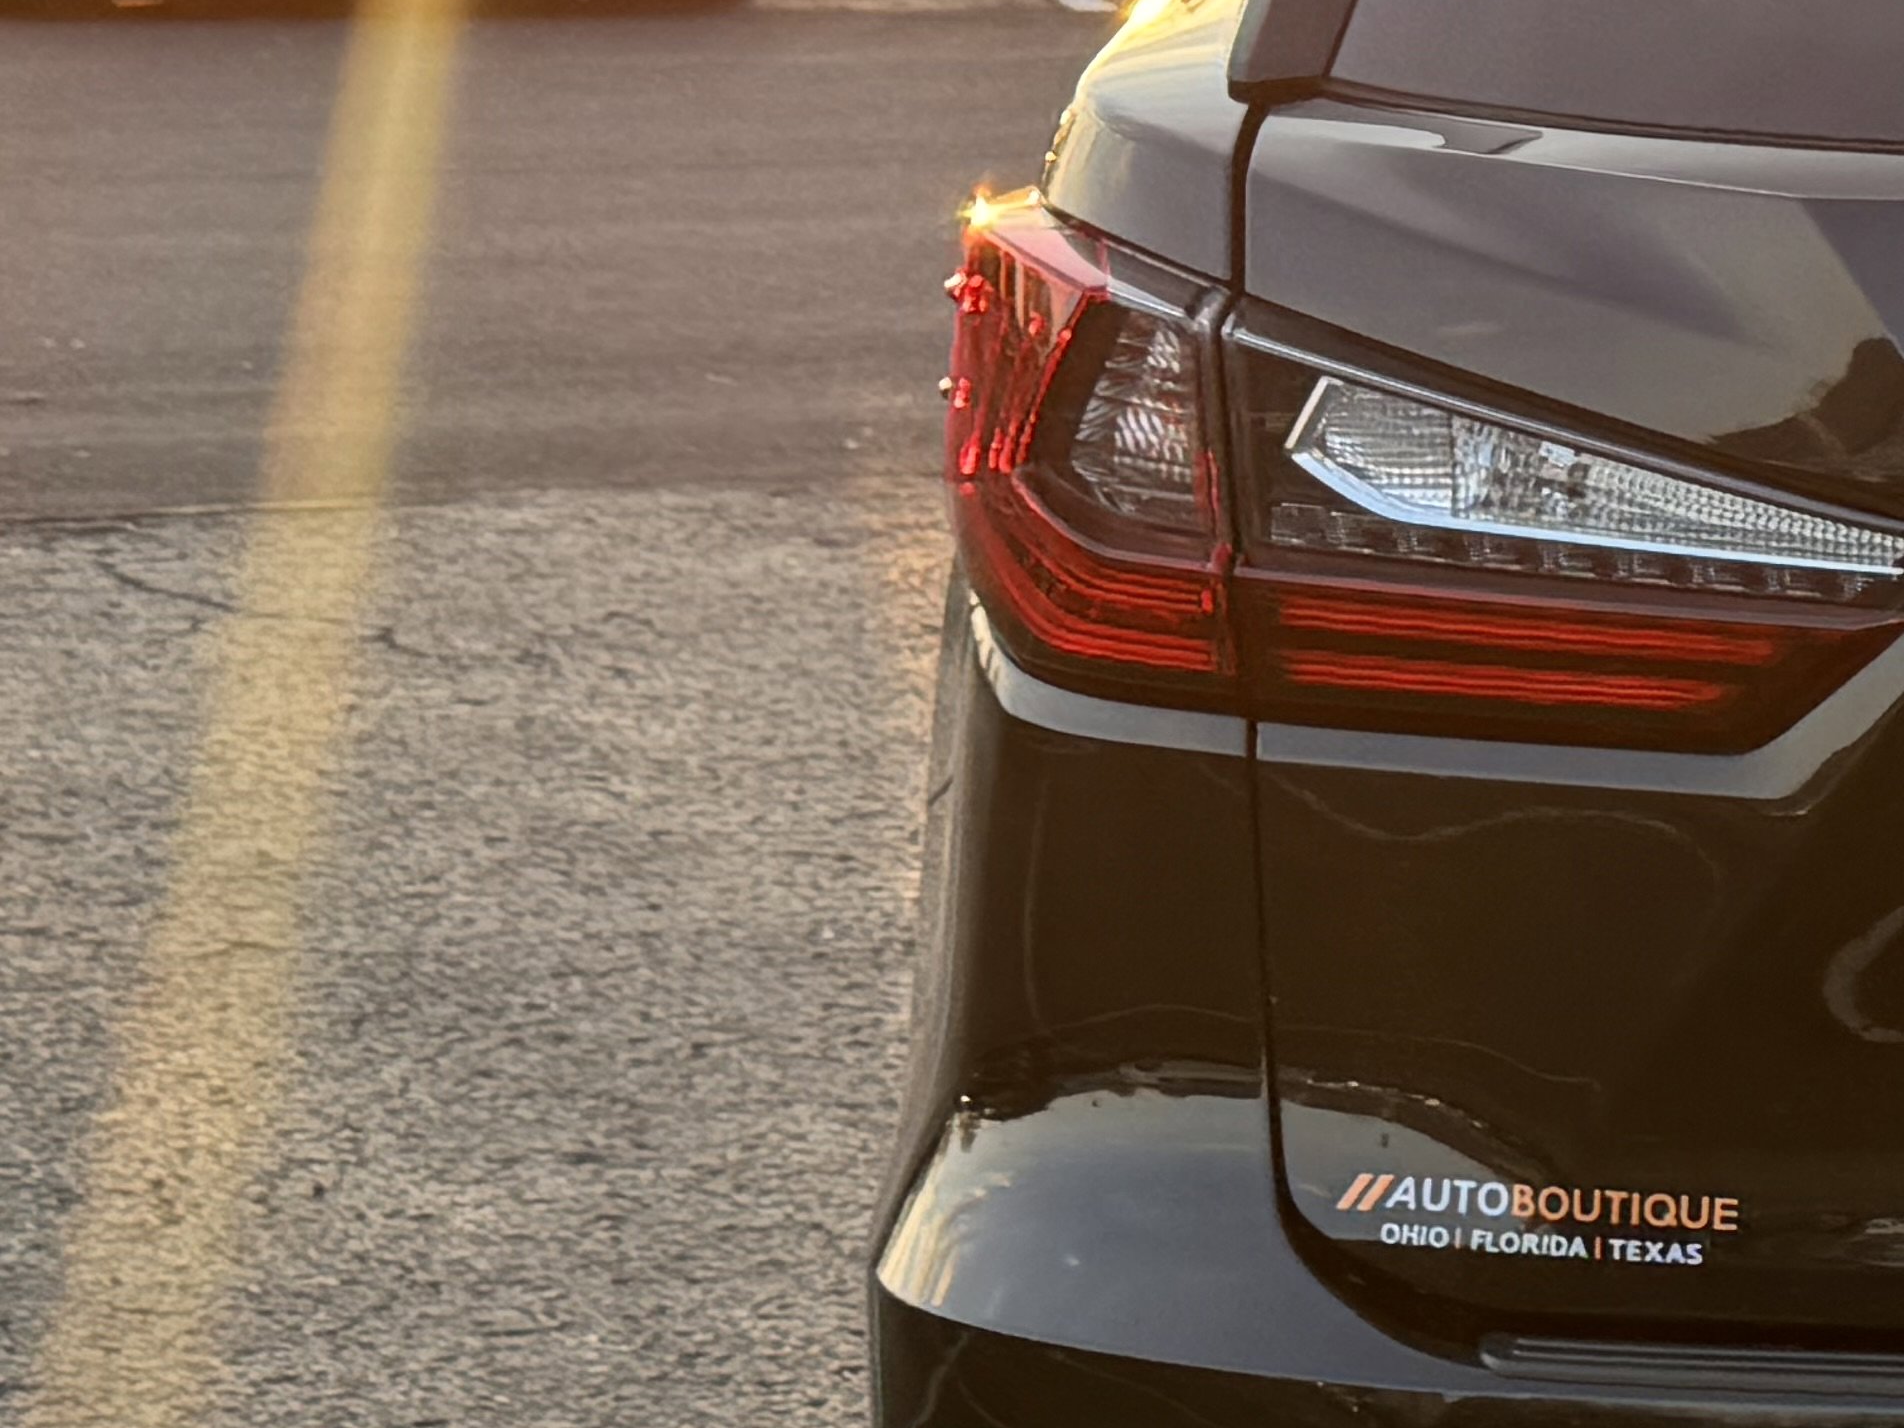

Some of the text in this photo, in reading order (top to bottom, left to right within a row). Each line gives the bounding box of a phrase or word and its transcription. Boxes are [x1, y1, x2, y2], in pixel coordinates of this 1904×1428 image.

[1385, 1176, 1740, 1232] AUTOBOUTIQUE
[1380, 1222, 1703, 1265] OHIO FLORIDA TEXAS
